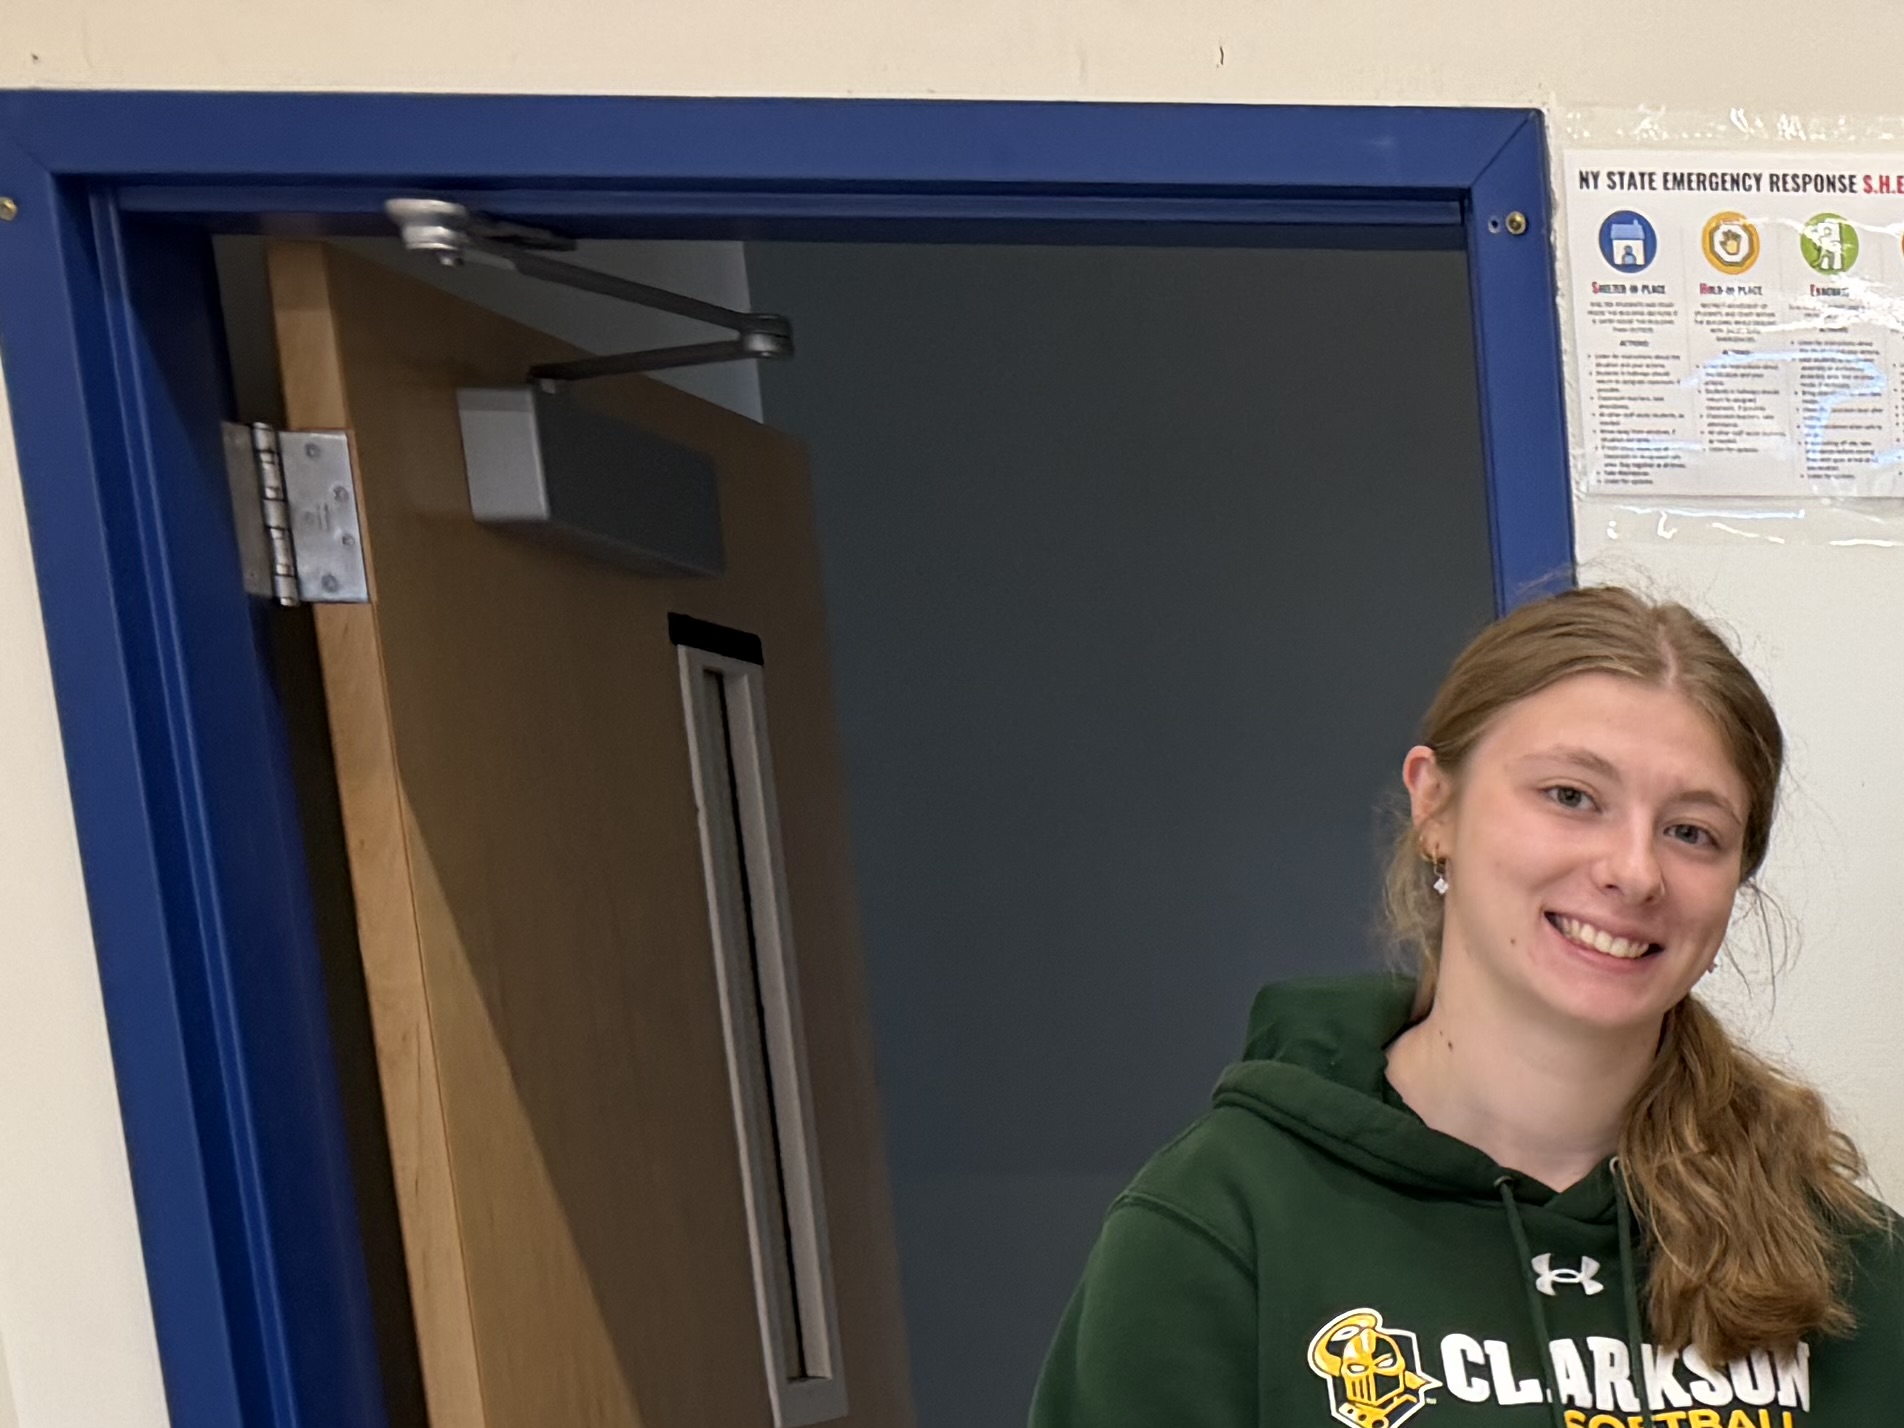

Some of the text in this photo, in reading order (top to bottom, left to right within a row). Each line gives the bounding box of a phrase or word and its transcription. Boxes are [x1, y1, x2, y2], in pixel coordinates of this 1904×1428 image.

[1578, 169, 1601, 190] NY
[1607, 170, 1657, 191] STATE
[1662, 171, 1763, 193] EMERGENCY
[1769, 173, 1857, 194] RESPONSE
[1440, 1333, 1811, 1413] CLARKSON
